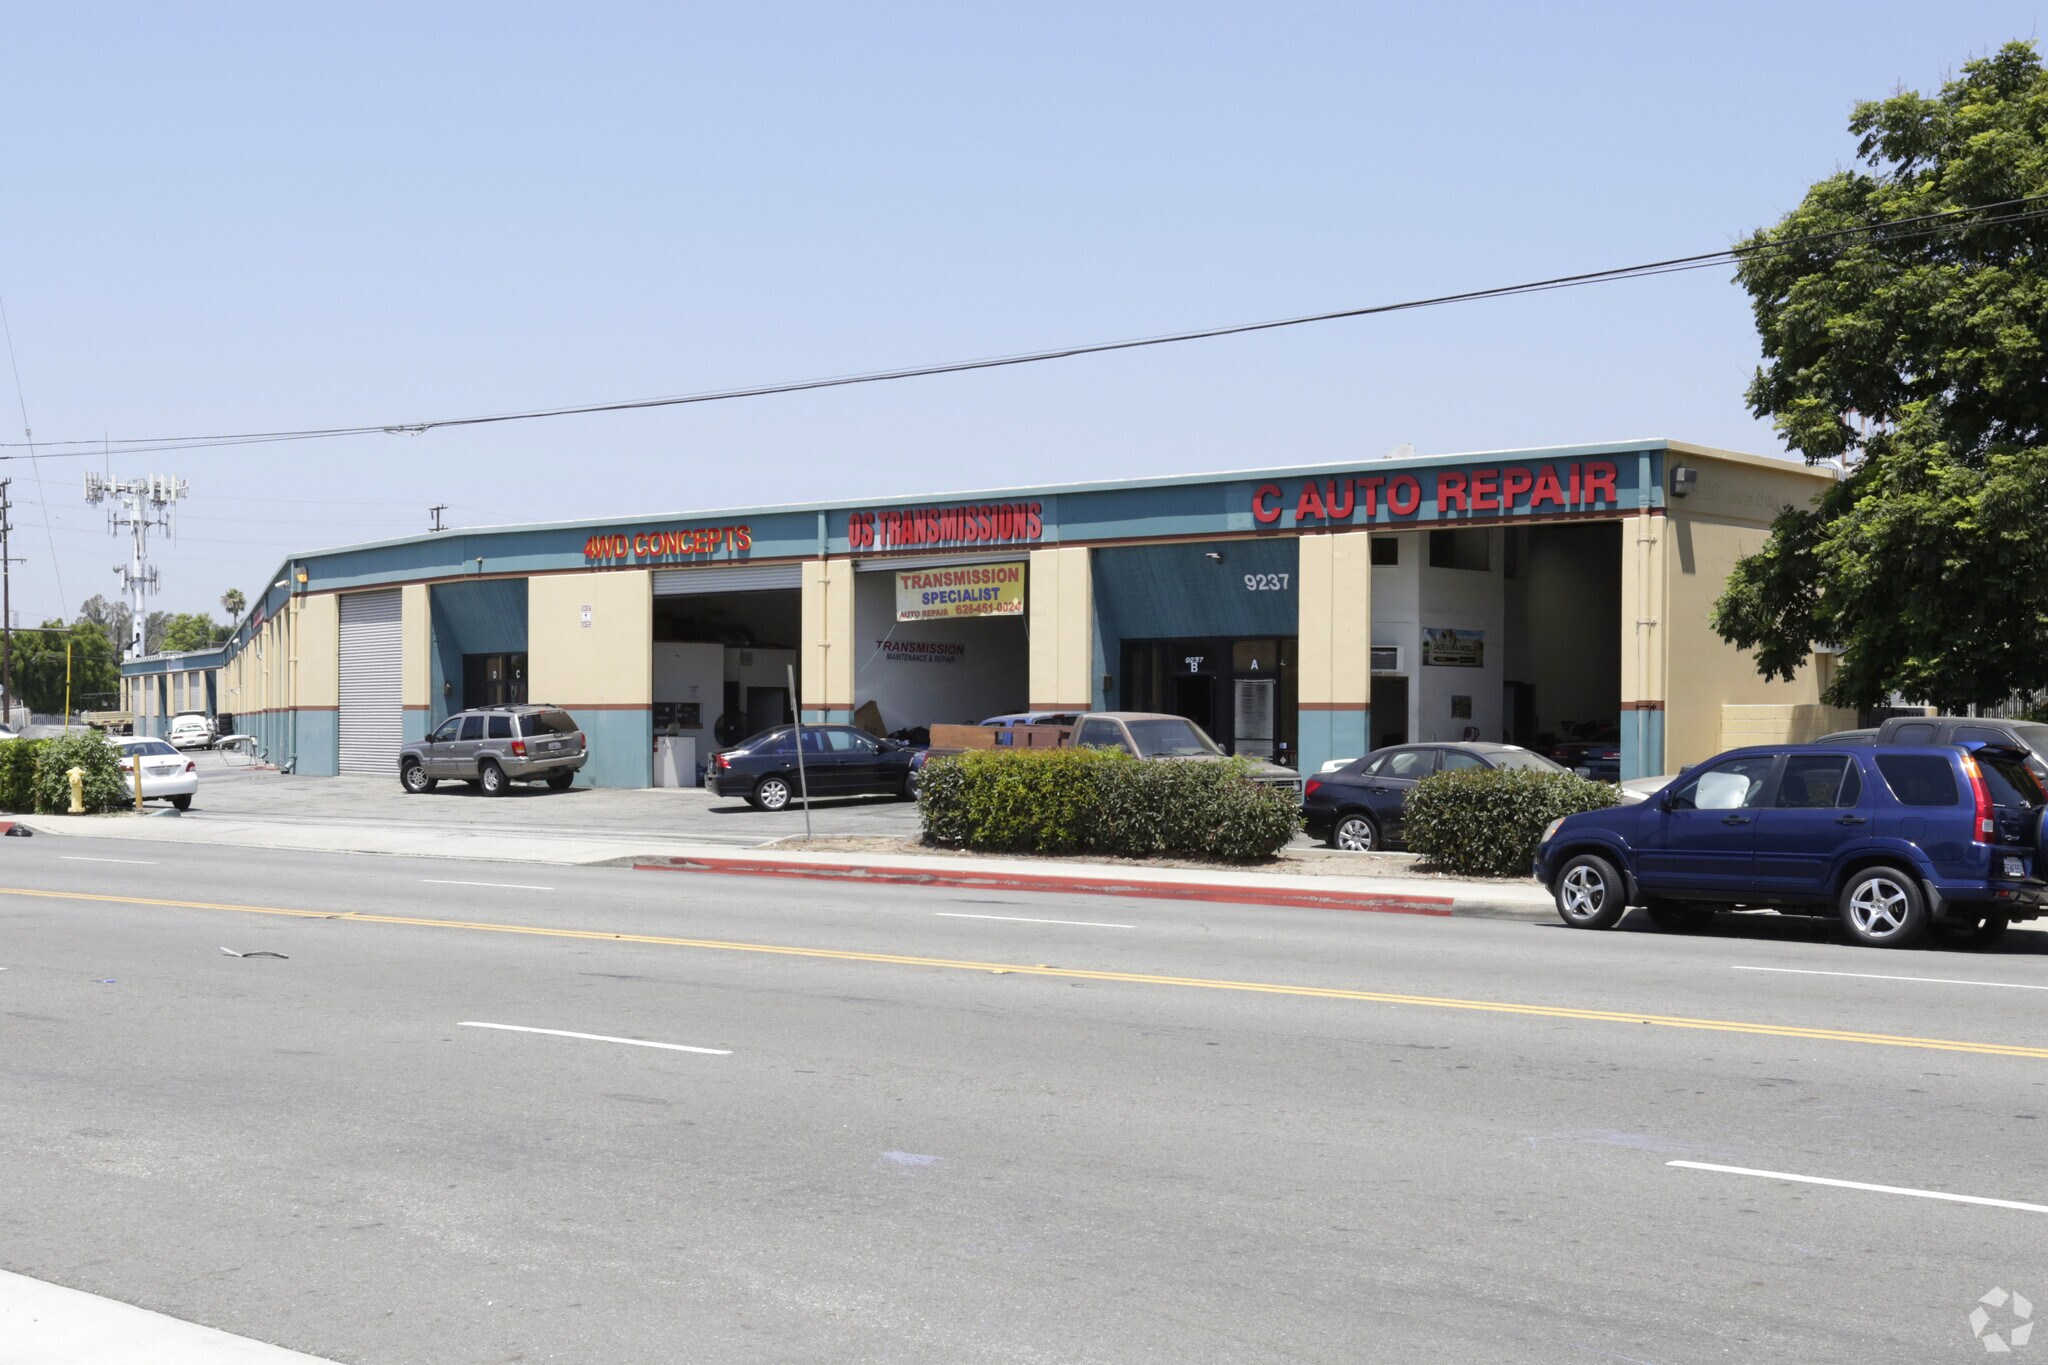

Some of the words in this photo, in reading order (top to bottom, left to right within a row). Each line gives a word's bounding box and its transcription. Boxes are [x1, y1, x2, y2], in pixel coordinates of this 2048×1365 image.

[1252, 483, 1283, 523] C
[1294, 475, 1421, 520] AUTO
[1437, 461, 1618, 513] REPAIR
[848, 512, 875, 548] OS
[877, 501, 1043, 546] TRANSMISSIONS
[583, 533, 629, 559] 4WD
[633, 524, 752, 557] CONCEPTS
[900, 567, 1019, 590] TRANSMISSION
[1244, 573, 1289, 591] 9237
[922, 587, 1000, 605] SPECIALIST
[900, 610, 920, 619] AUTO
[922, 608, 949, 617] REPAIR
[876, 640, 965, 655] TRANSMISSION
[886, 653, 928, 663] MAINTENANCE
[934, 655, 956, 663] REPAIR
[1185, 656, 1204, 664] 9237
[1250, 659, 1259, 670] A
[1190, 662, 1199, 673] B
